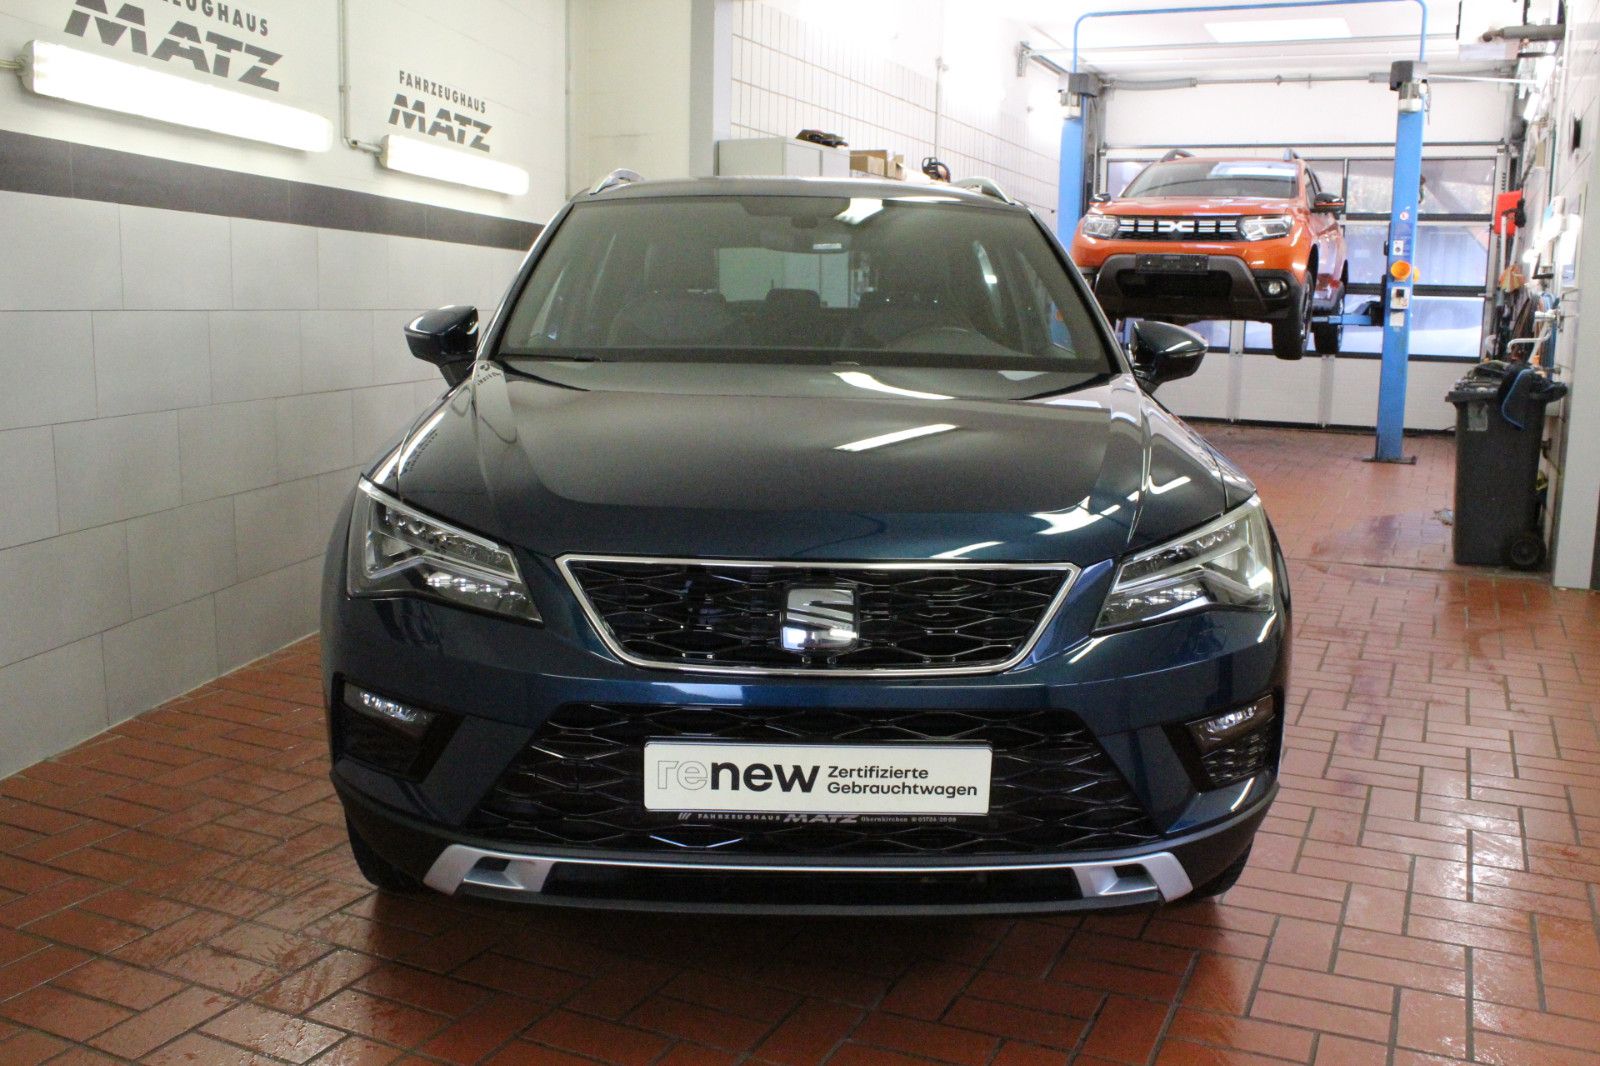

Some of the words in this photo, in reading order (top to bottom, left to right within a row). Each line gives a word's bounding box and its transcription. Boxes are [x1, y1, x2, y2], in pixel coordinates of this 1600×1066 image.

[64, 0, 284, 92] MATZ
[399, 70, 487, 114] FAHRZEUGHAUS
[388, 93, 493, 153] MATZ
[657, 760, 820, 793] renew
[827, 765, 929, 779] Zertifizierte
[827, 781, 978, 799] Gebrauchtwagen
[783, 813, 859, 824] MATZ
